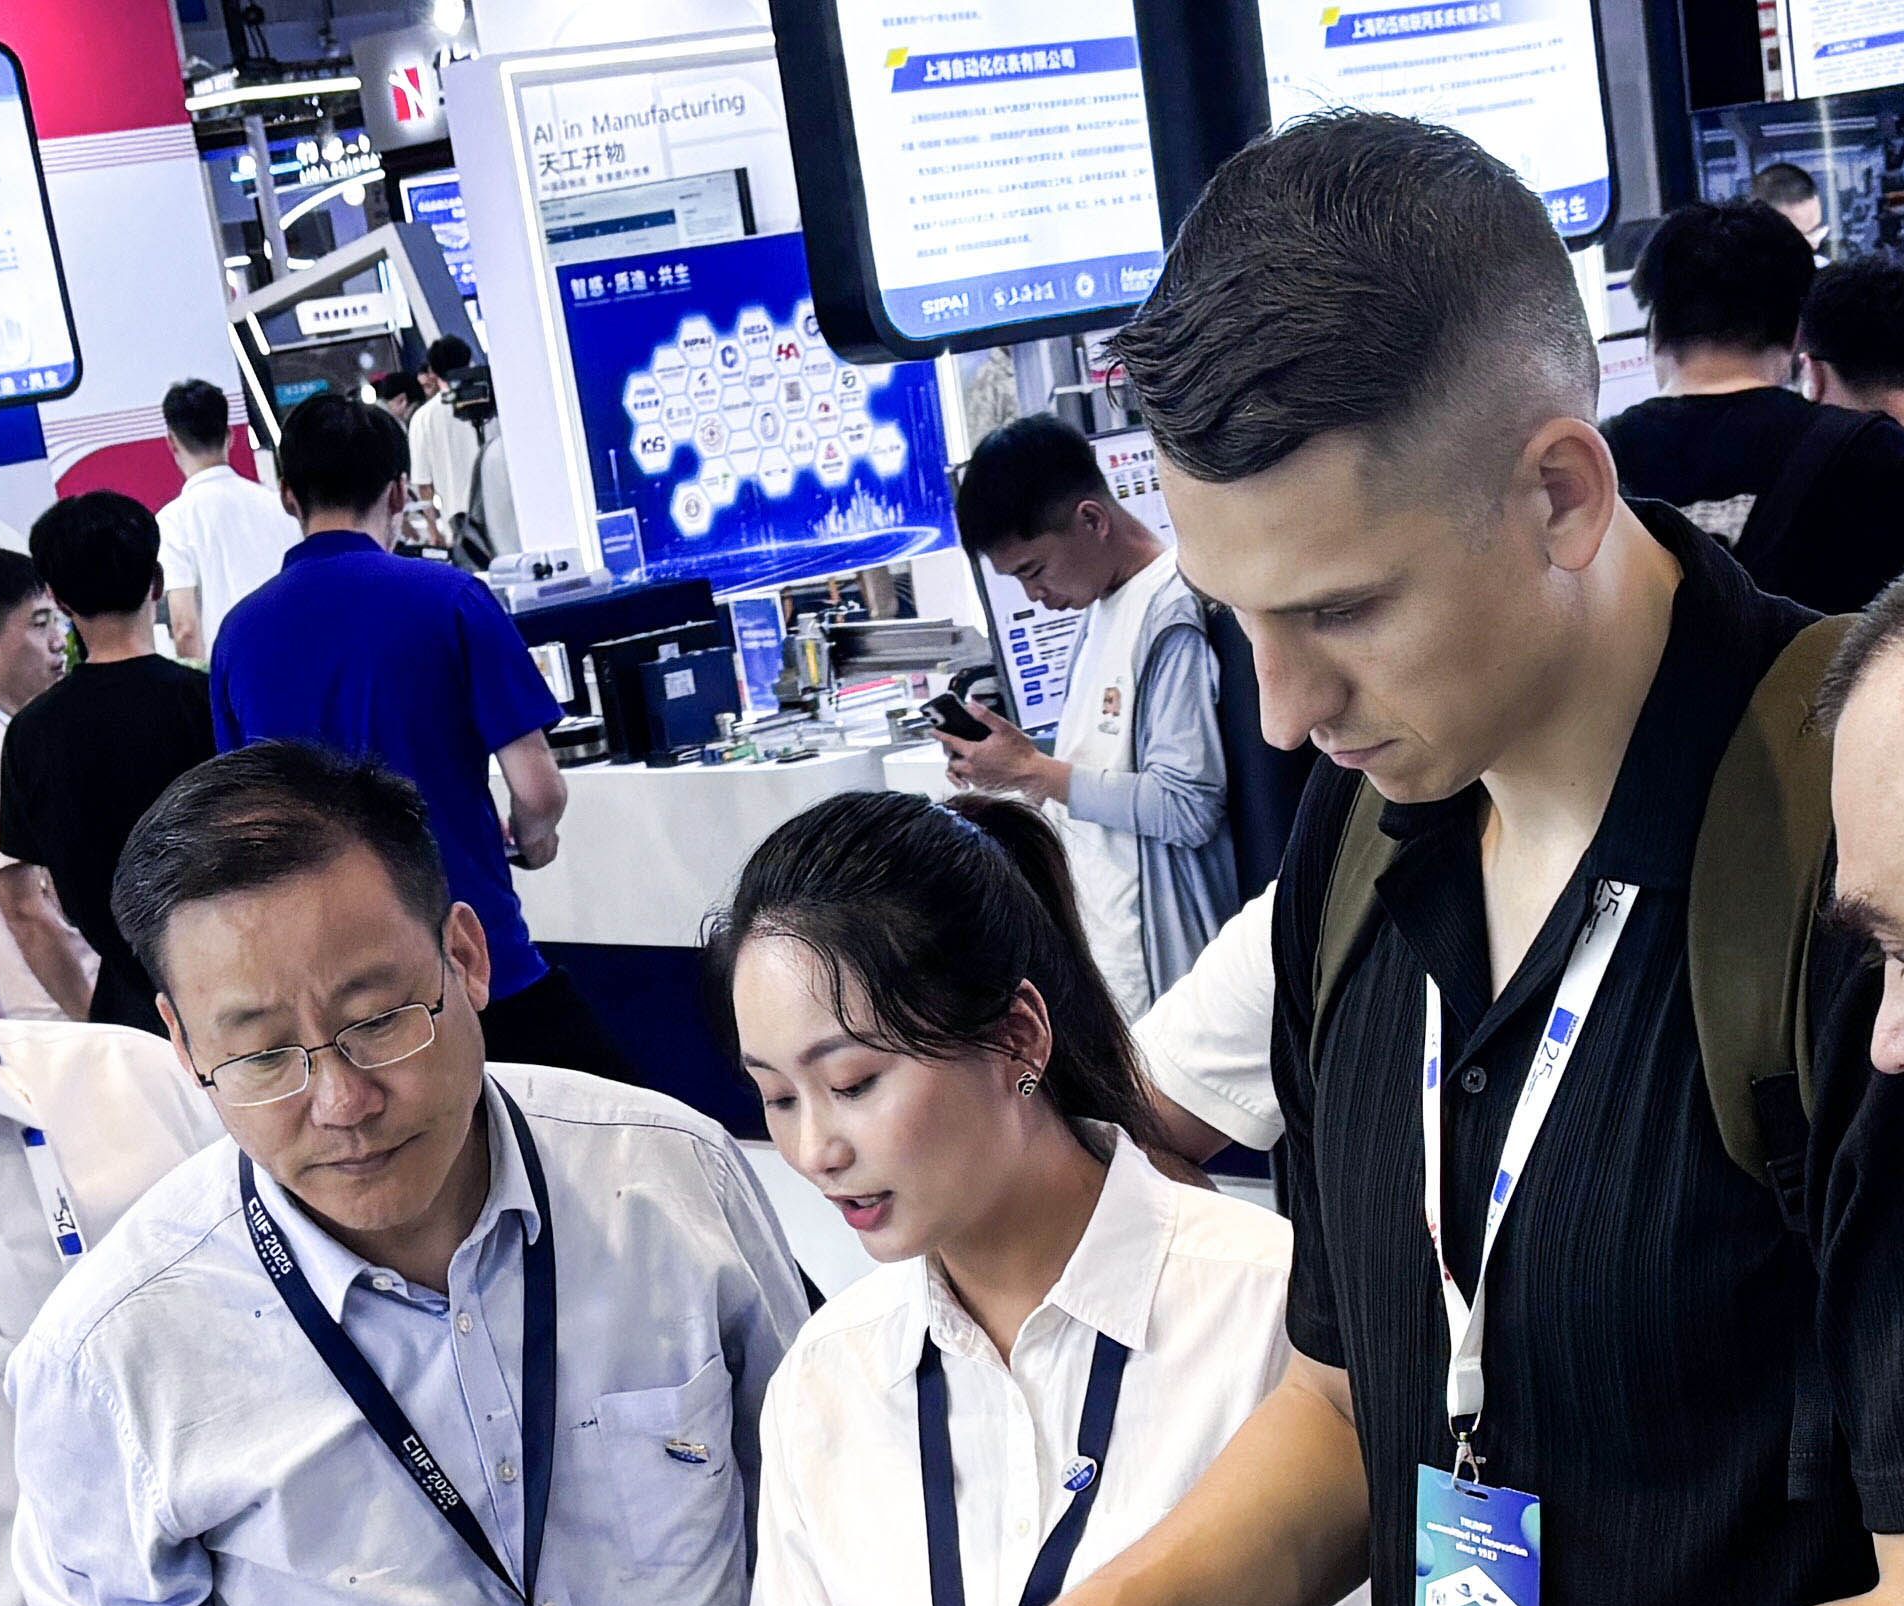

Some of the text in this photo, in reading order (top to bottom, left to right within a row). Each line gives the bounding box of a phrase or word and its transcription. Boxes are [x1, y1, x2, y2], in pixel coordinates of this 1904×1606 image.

[533, 94, 747, 146] AI in Manufacturing
[538, 140, 627, 177] 天工开物
[247, 1196, 294, 1275] CIIF 2025
[402, 1434, 460, 1507] CIIF 2025
